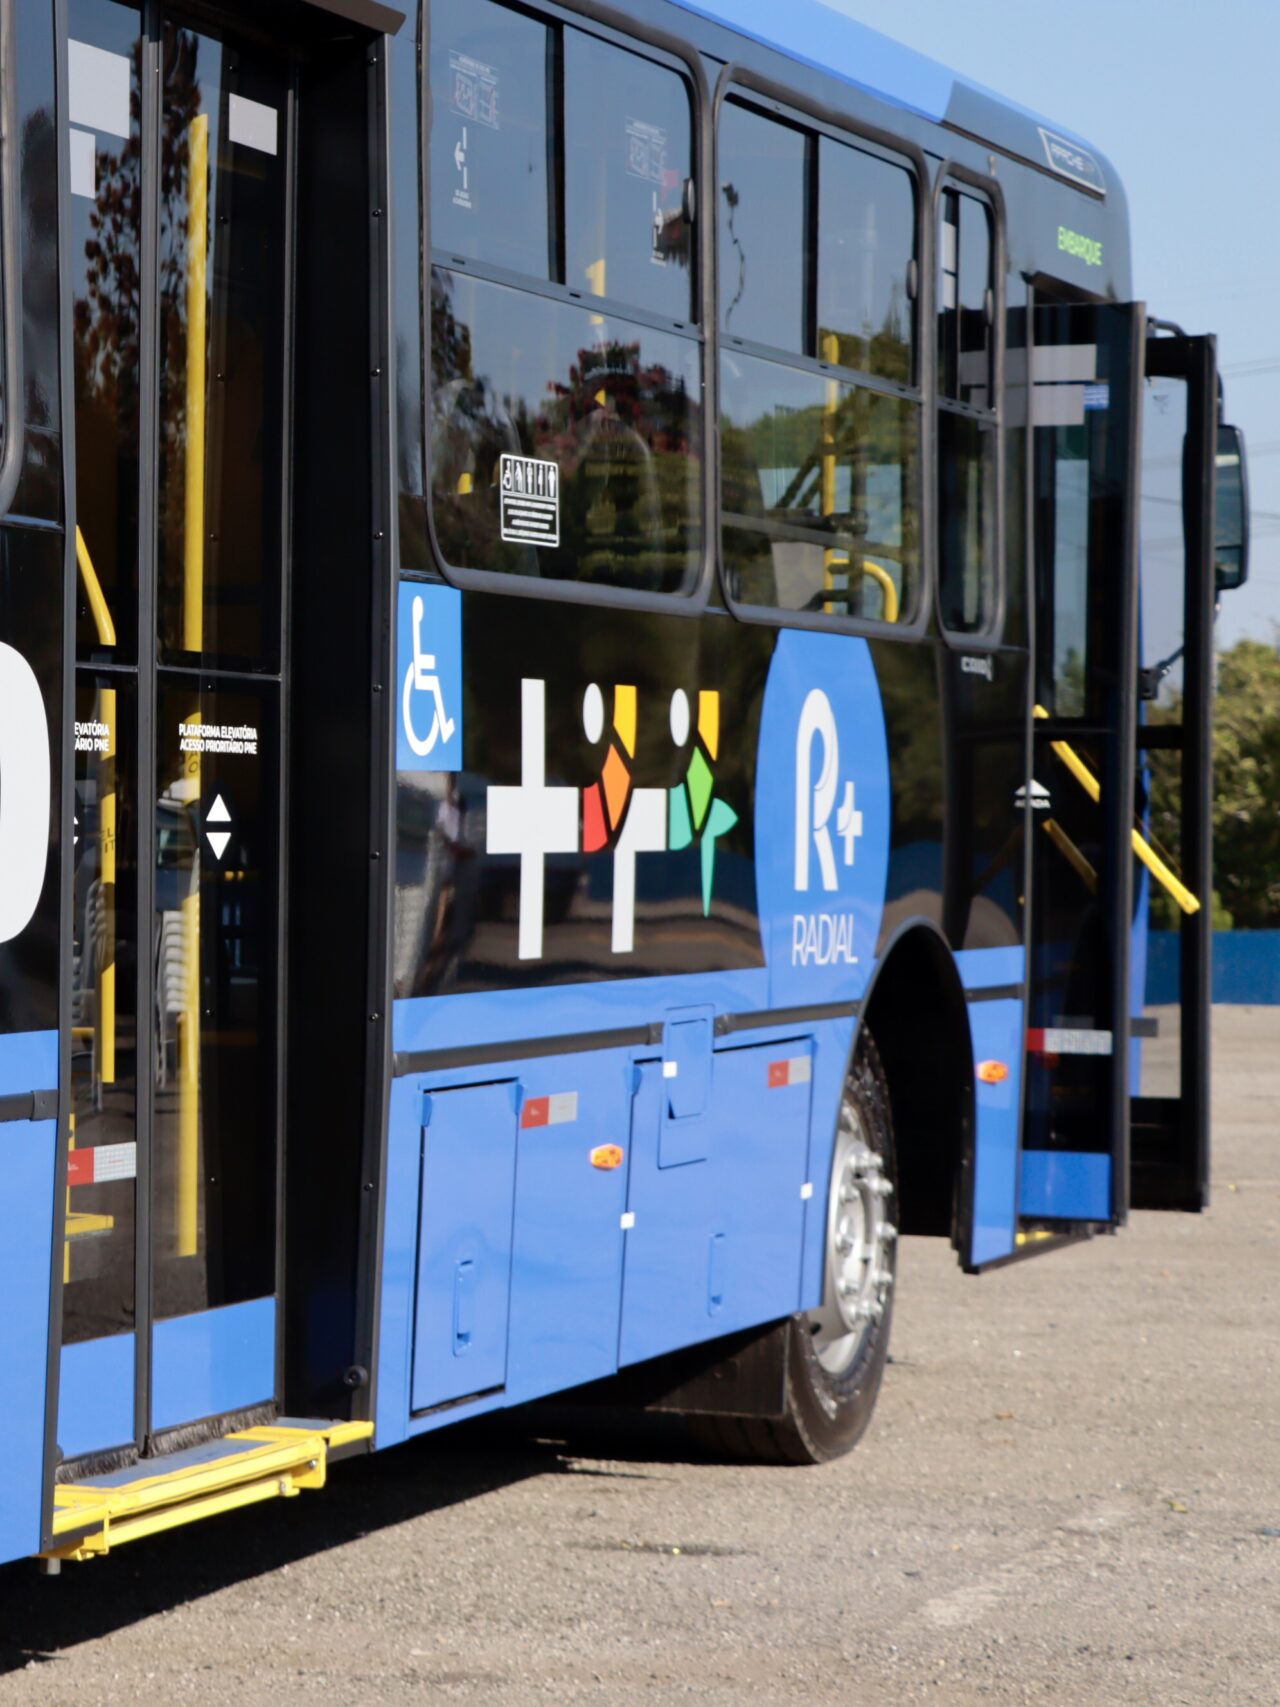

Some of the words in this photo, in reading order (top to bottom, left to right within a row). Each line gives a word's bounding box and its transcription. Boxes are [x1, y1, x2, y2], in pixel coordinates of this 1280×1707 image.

[179, 723, 220, 738] PLATAFORMA
[221, 724, 257, 740] ELEVATÓRIA
[94, 738, 109, 752] PNE
[180, 738, 205, 752] ACESSO
[205, 738, 243, 754] PRIORITÁRIO
[244, 741, 257, 755] PNE
[792, 914, 859, 966] RADIAL
